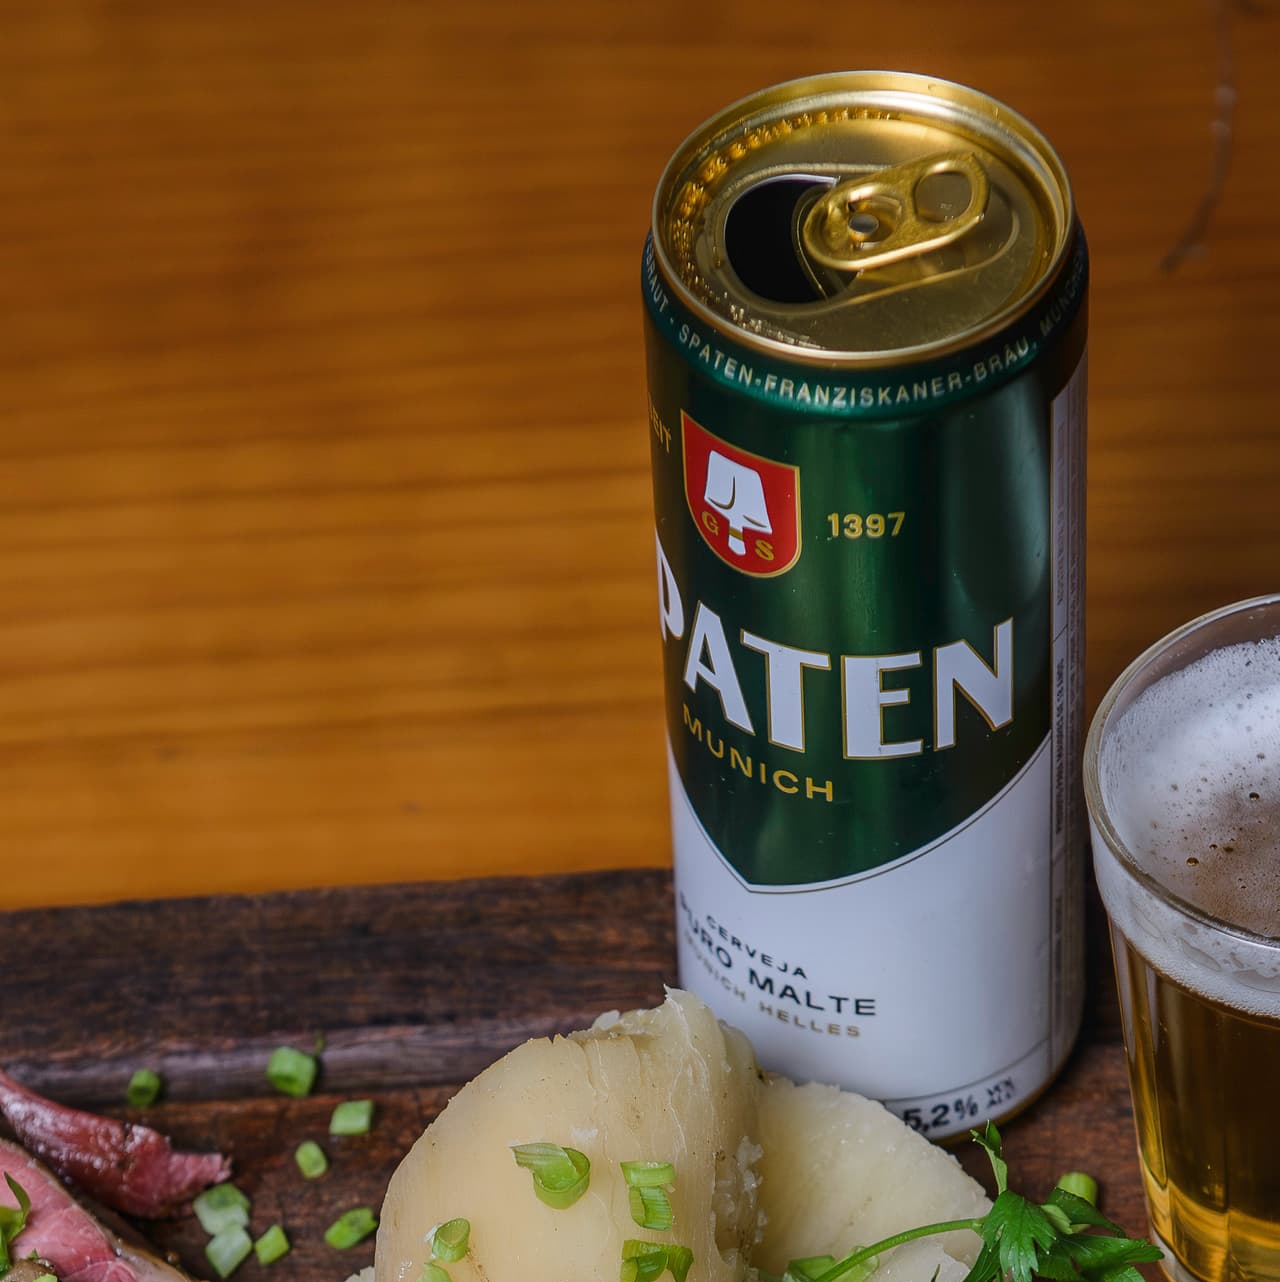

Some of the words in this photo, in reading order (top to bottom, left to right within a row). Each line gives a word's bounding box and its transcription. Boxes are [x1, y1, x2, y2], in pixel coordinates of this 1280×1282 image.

[701, 511, 720, 537] G
[755, 539, 775, 561] S
[827, 511, 906, 539] 1397
[655, 527, 1014, 760] PATEN
[683, 703, 834, 802] MUNICH
[706, 915, 808, 980] CERVEJA
[748, 967, 877, 1017] MALTE
[758, 1001, 861, 1038] HELLES
[903, 1095, 979, 1133] 5,2%
